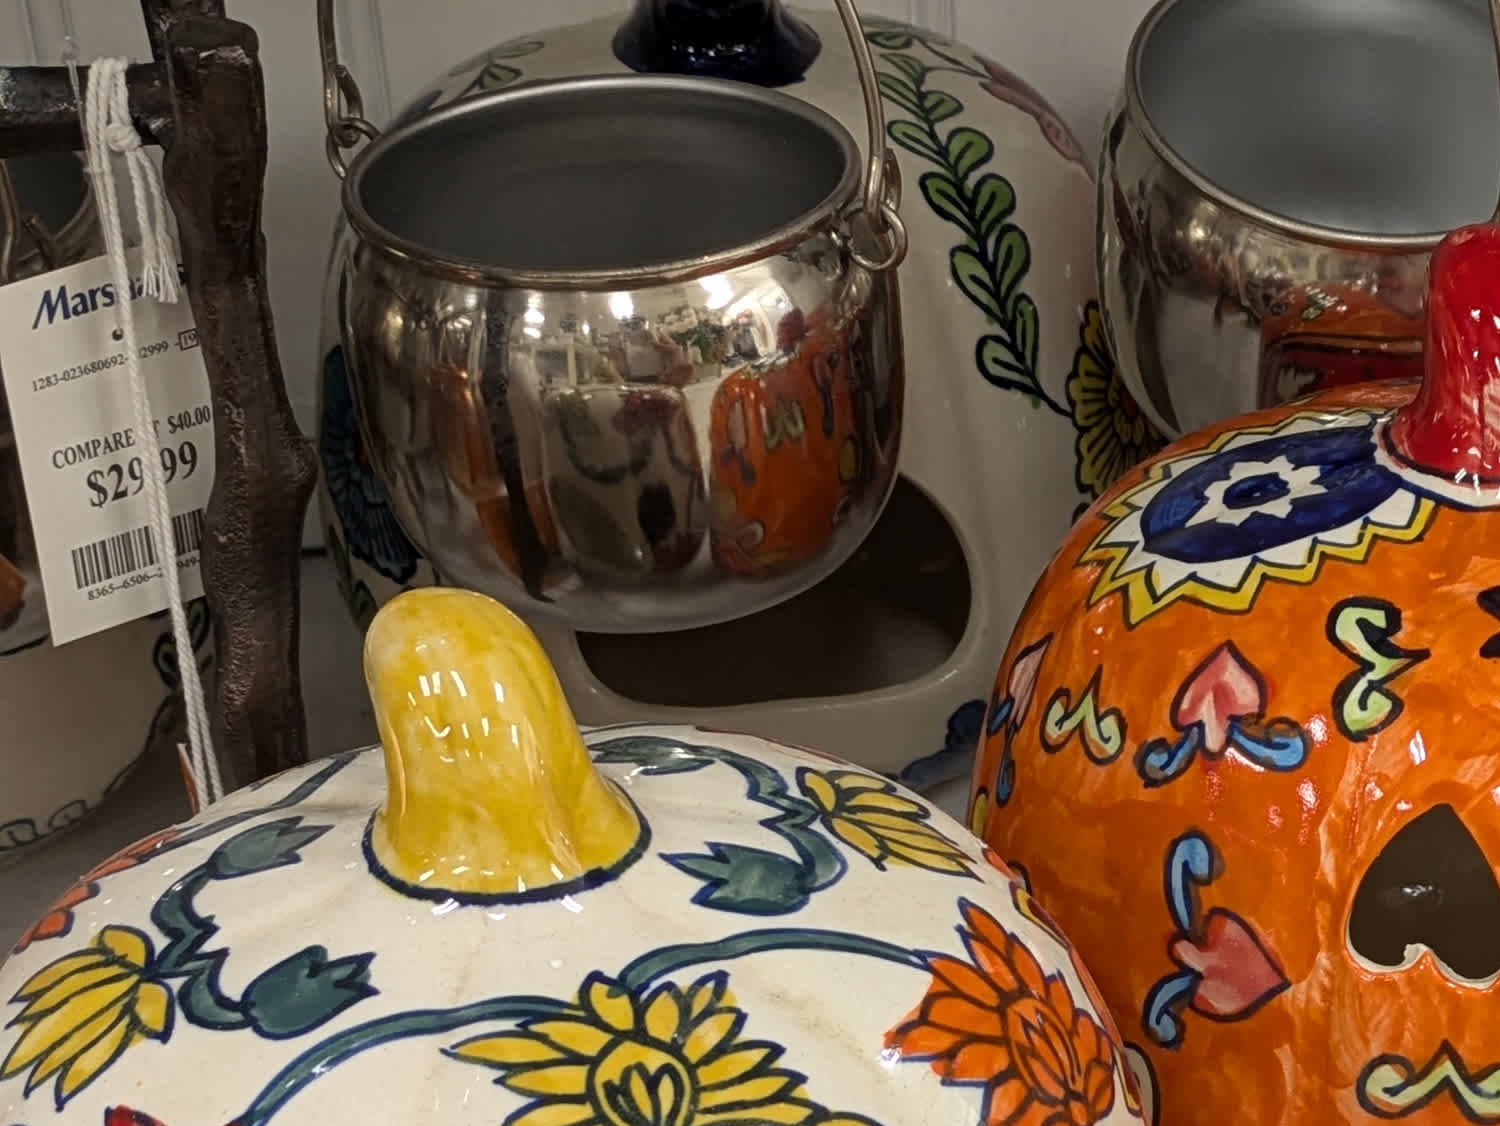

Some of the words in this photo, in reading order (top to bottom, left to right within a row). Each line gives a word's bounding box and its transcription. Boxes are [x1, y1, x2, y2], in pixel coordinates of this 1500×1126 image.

[53, 428, 136, 469] COMPARE
[168, 405, 211, 434] $40.00
[86, 441, 198, 508] $2999
